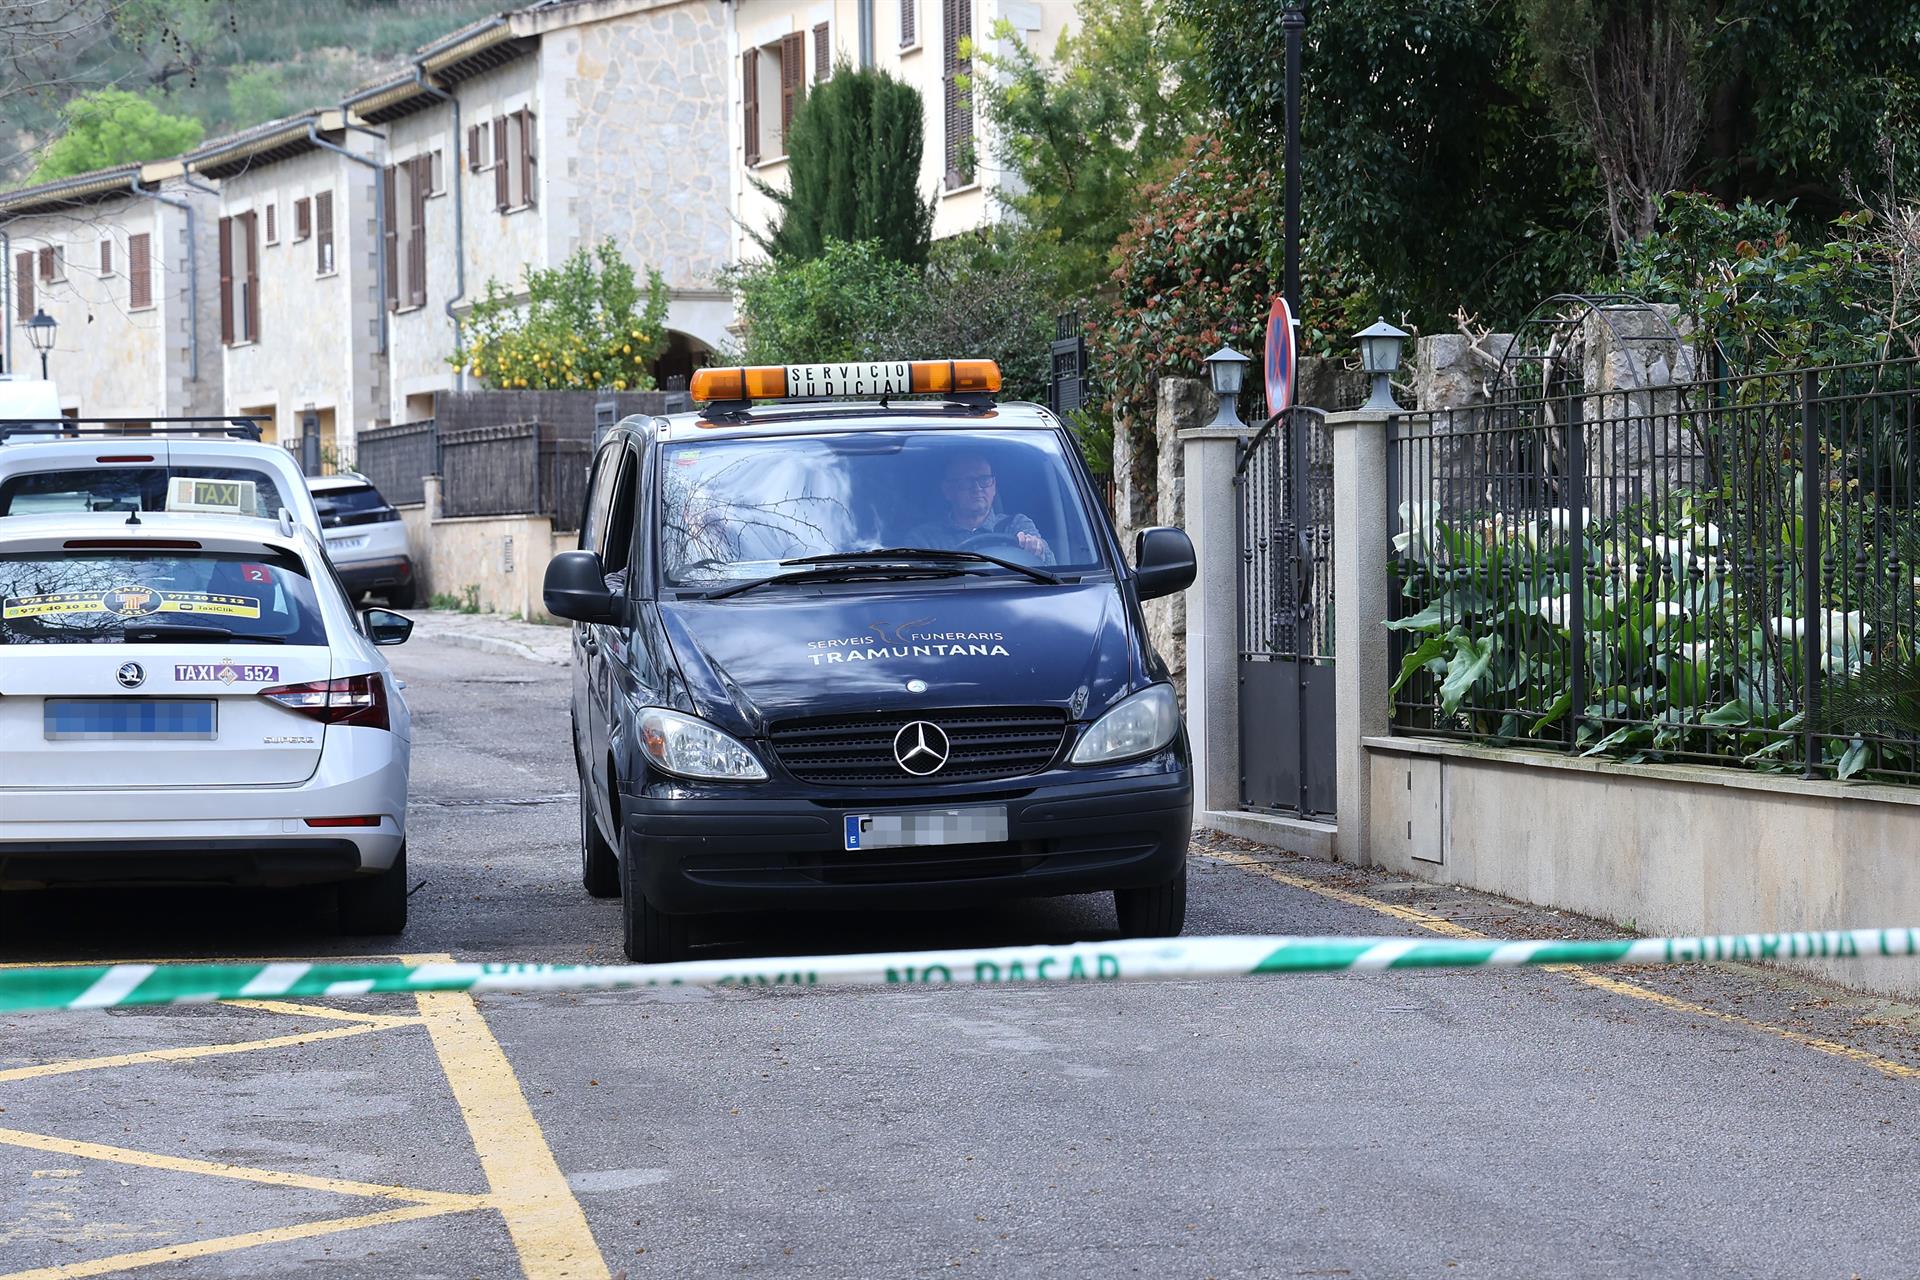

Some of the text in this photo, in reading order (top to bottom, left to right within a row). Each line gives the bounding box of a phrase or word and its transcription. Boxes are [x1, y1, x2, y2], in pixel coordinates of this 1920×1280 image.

[791, 364, 905, 381] SERVICIO
[791, 379, 905, 397] JUDICIAL
[196, 483, 239, 505] TAXI
[250, 570, 264, 581] 2
[113, 586, 153, 594] RADIO
[20, 597, 43, 605] 971
[807, 632, 1004, 650] SERVEIS FUNERARIS
[807, 644, 1010, 666] TRAMUNTANA
[176, 665, 274, 681] TAXI 552
